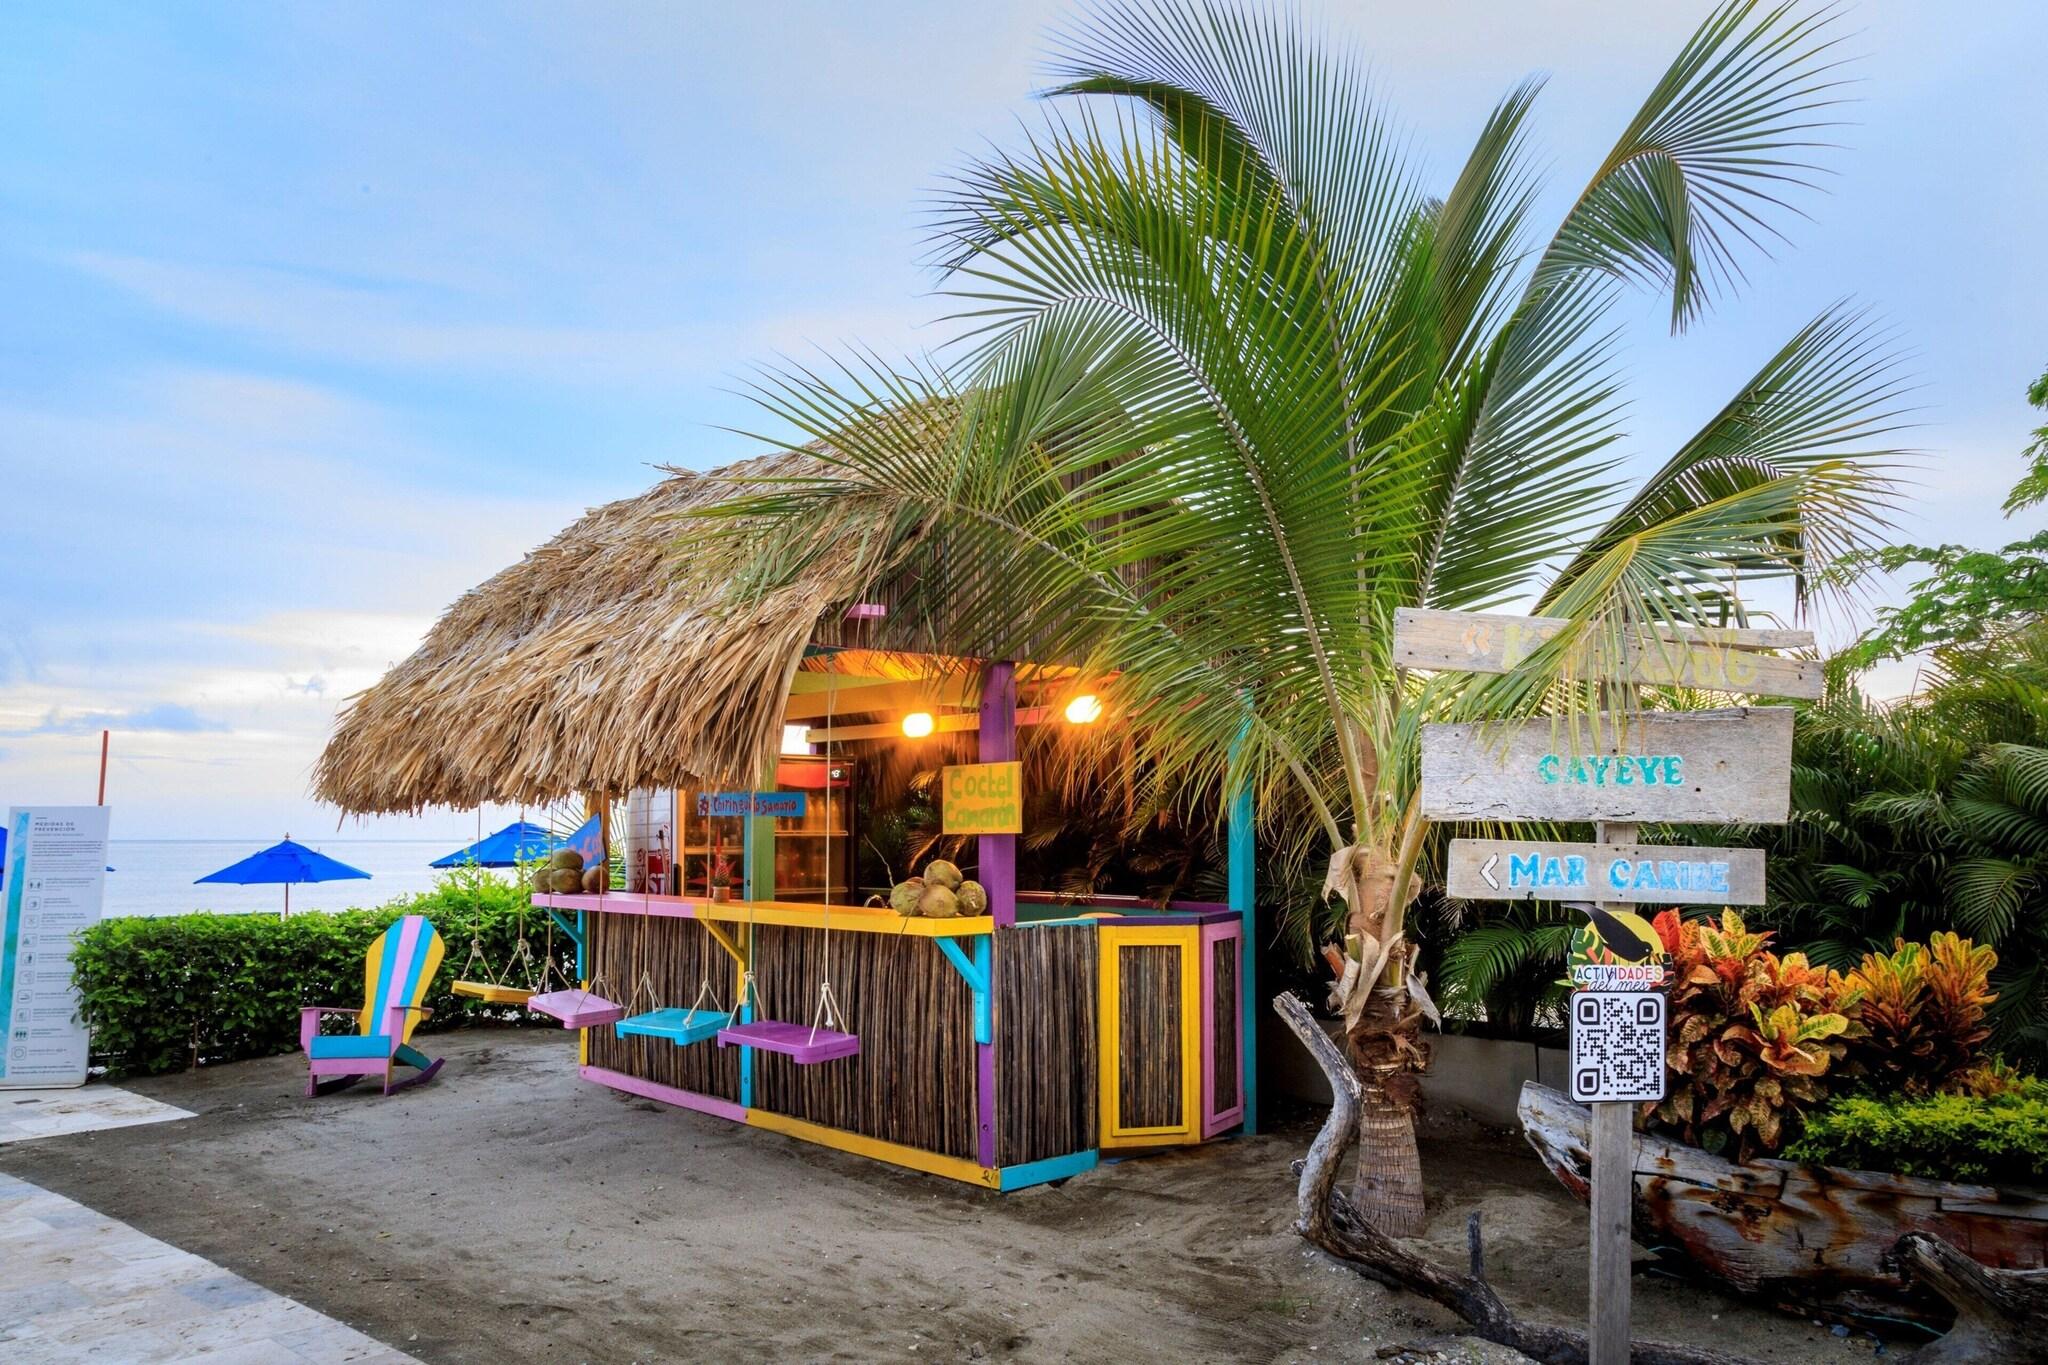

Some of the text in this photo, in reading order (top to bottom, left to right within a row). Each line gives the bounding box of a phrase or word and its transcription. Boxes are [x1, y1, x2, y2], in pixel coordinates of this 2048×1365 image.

[950, 764, 1013, 799] Coctel
[1537, 754, 1686, 787] CAYEYE
[1508, 852, 1730, 893] MAR CARIBE
[1575, 966, 1664, 981] ACTIVIDADES
[1588, 971, 1650, 991] del mes
